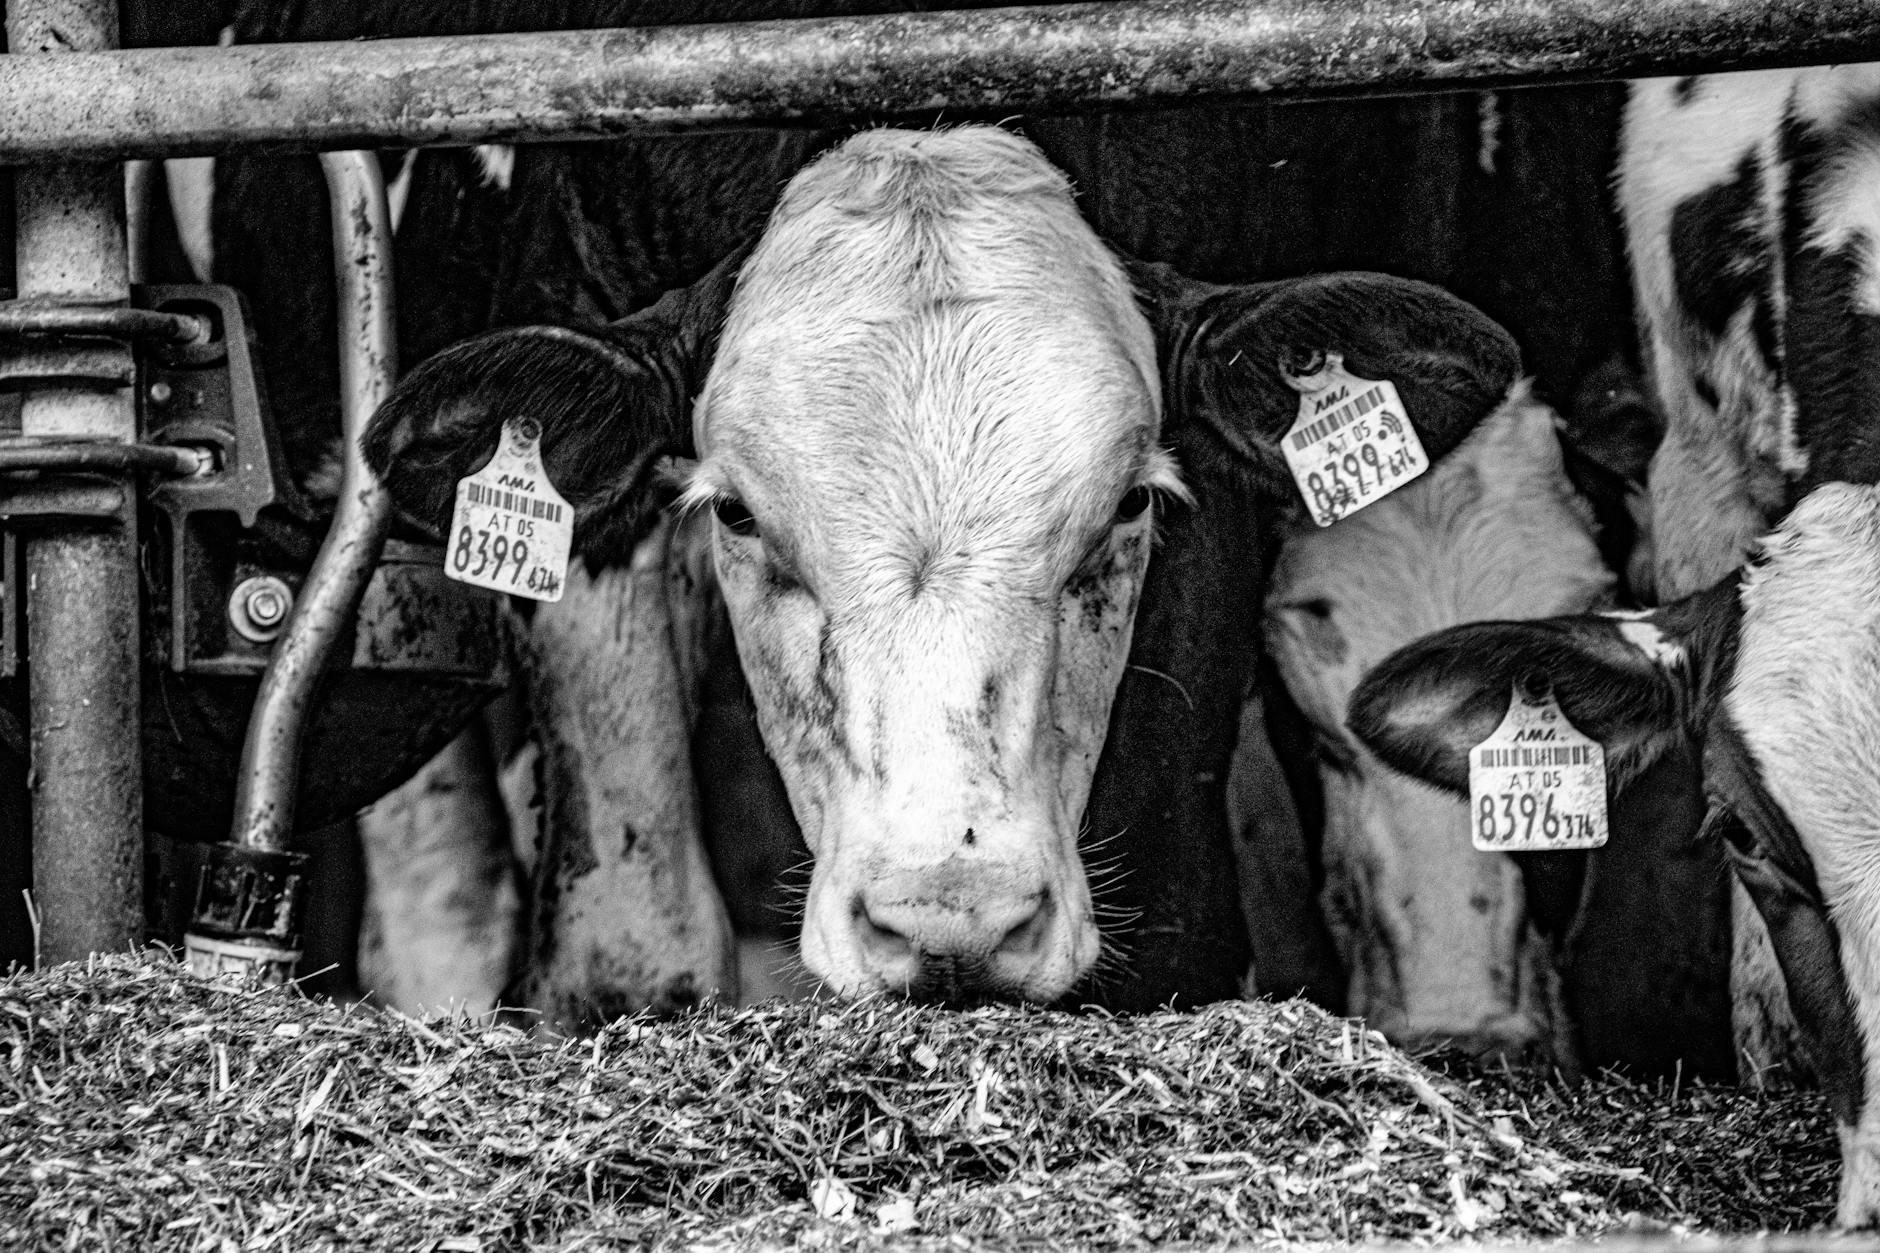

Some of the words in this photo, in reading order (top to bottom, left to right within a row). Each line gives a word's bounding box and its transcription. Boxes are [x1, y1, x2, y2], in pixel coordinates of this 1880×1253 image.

[1327, 433, 1347, 455] AT
[1351, 420, 1371, 442] 05
[1308, 443, 1383, 515] 8399
[488, 512, 511, 532] AT
[517, 518, 534, 537] 05
[454, 525, 528, 585] 8399
[1509, 771, 1535, 789] AT
[1543, 771, 1561, 788] 05
[1480, 793, 1560, 841] 8396
